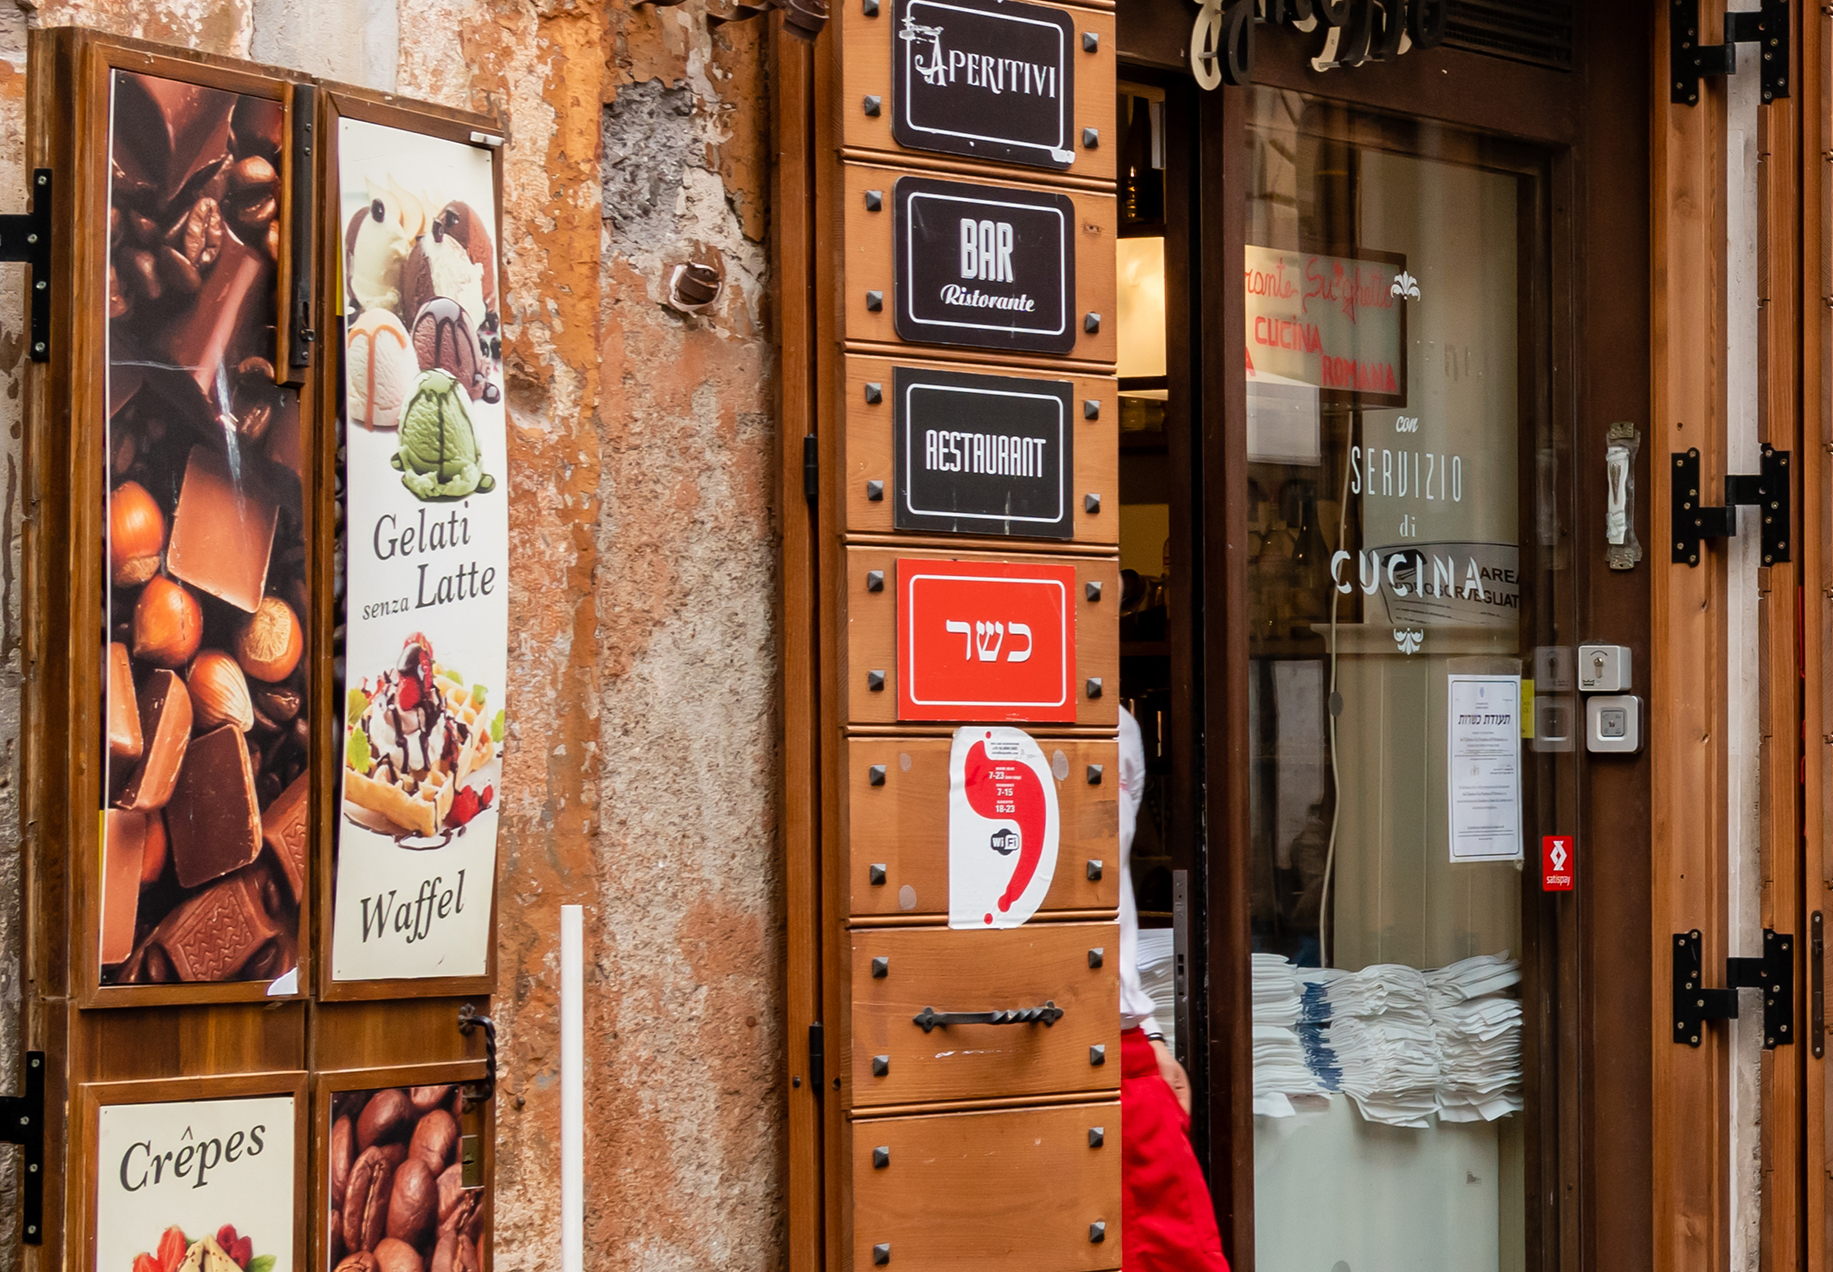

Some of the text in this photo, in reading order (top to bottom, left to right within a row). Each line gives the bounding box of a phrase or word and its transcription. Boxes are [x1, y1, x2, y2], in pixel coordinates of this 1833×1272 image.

[960, 217, 1014, 283] BAR
[940, 283, 1036, 313] Ristorante
[1321, 354, 1397, 392] ROMANA
[1395, 415, 1419, 433] con
[925, 429, 1047, 478] RESTAURANT
[1351, 445, 1462, 502] SERVIZIO
[373, 500, 471, 561] Gelati
[1399, 514, 1416, 537] di
[362, 561, 496, 621] senza Latte
[1330, 549, 1485, 600] CUCINA
[945, 620, 1033, 663] כשר
[988, 771, 1005, 780] 7-23
[997, 788, 1013, 797] 7-15
[995, 804, 1016, 813] 18-23
[1546, 874, 1571, 886] satispay
[360, 868, 466, 944] Waffel
[119, 1124, 266, 1192] Crêpes
